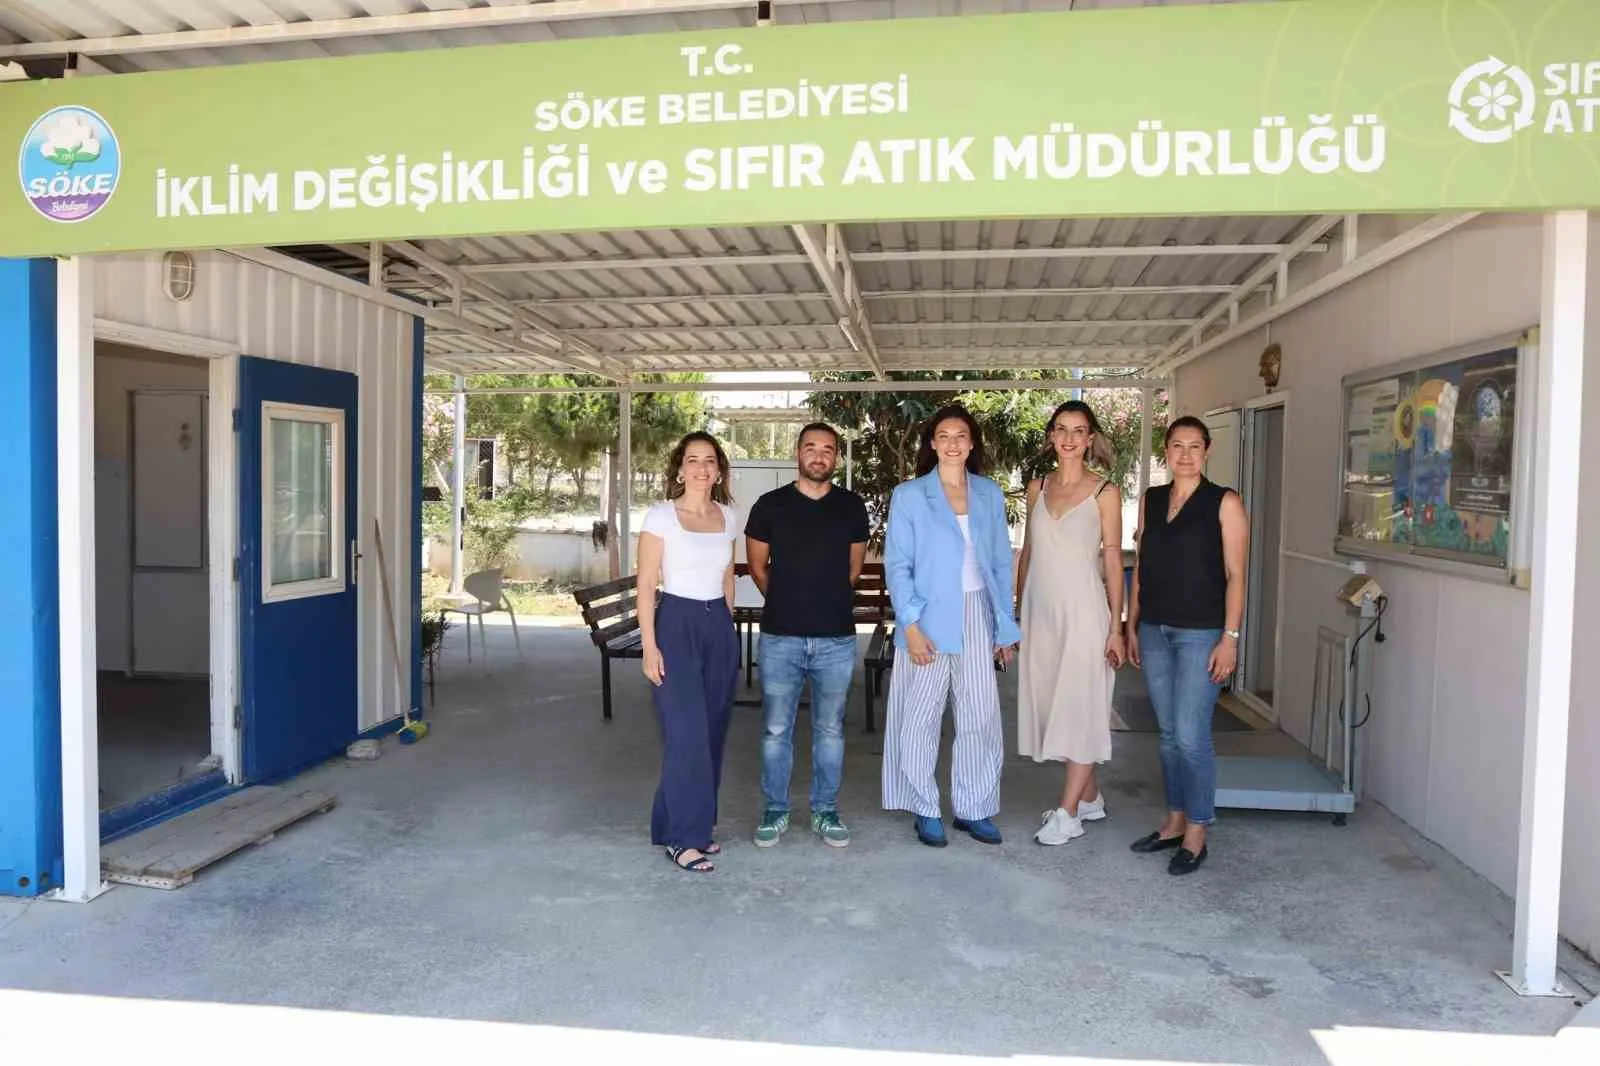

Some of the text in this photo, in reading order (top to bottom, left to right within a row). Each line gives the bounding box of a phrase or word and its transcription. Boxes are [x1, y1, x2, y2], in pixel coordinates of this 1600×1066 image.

[681, 44, 753, 77] T.C.
[535, 73, 908, 131] SÖKE BELEDİYESİ
[29, 171, 112, 198] SÖKE
[156, 113, 1386, 216] İKLİM DEĞİŞİKLİĞİ ve SIFIR ATIK MÜDÜRLÜĞÜ
